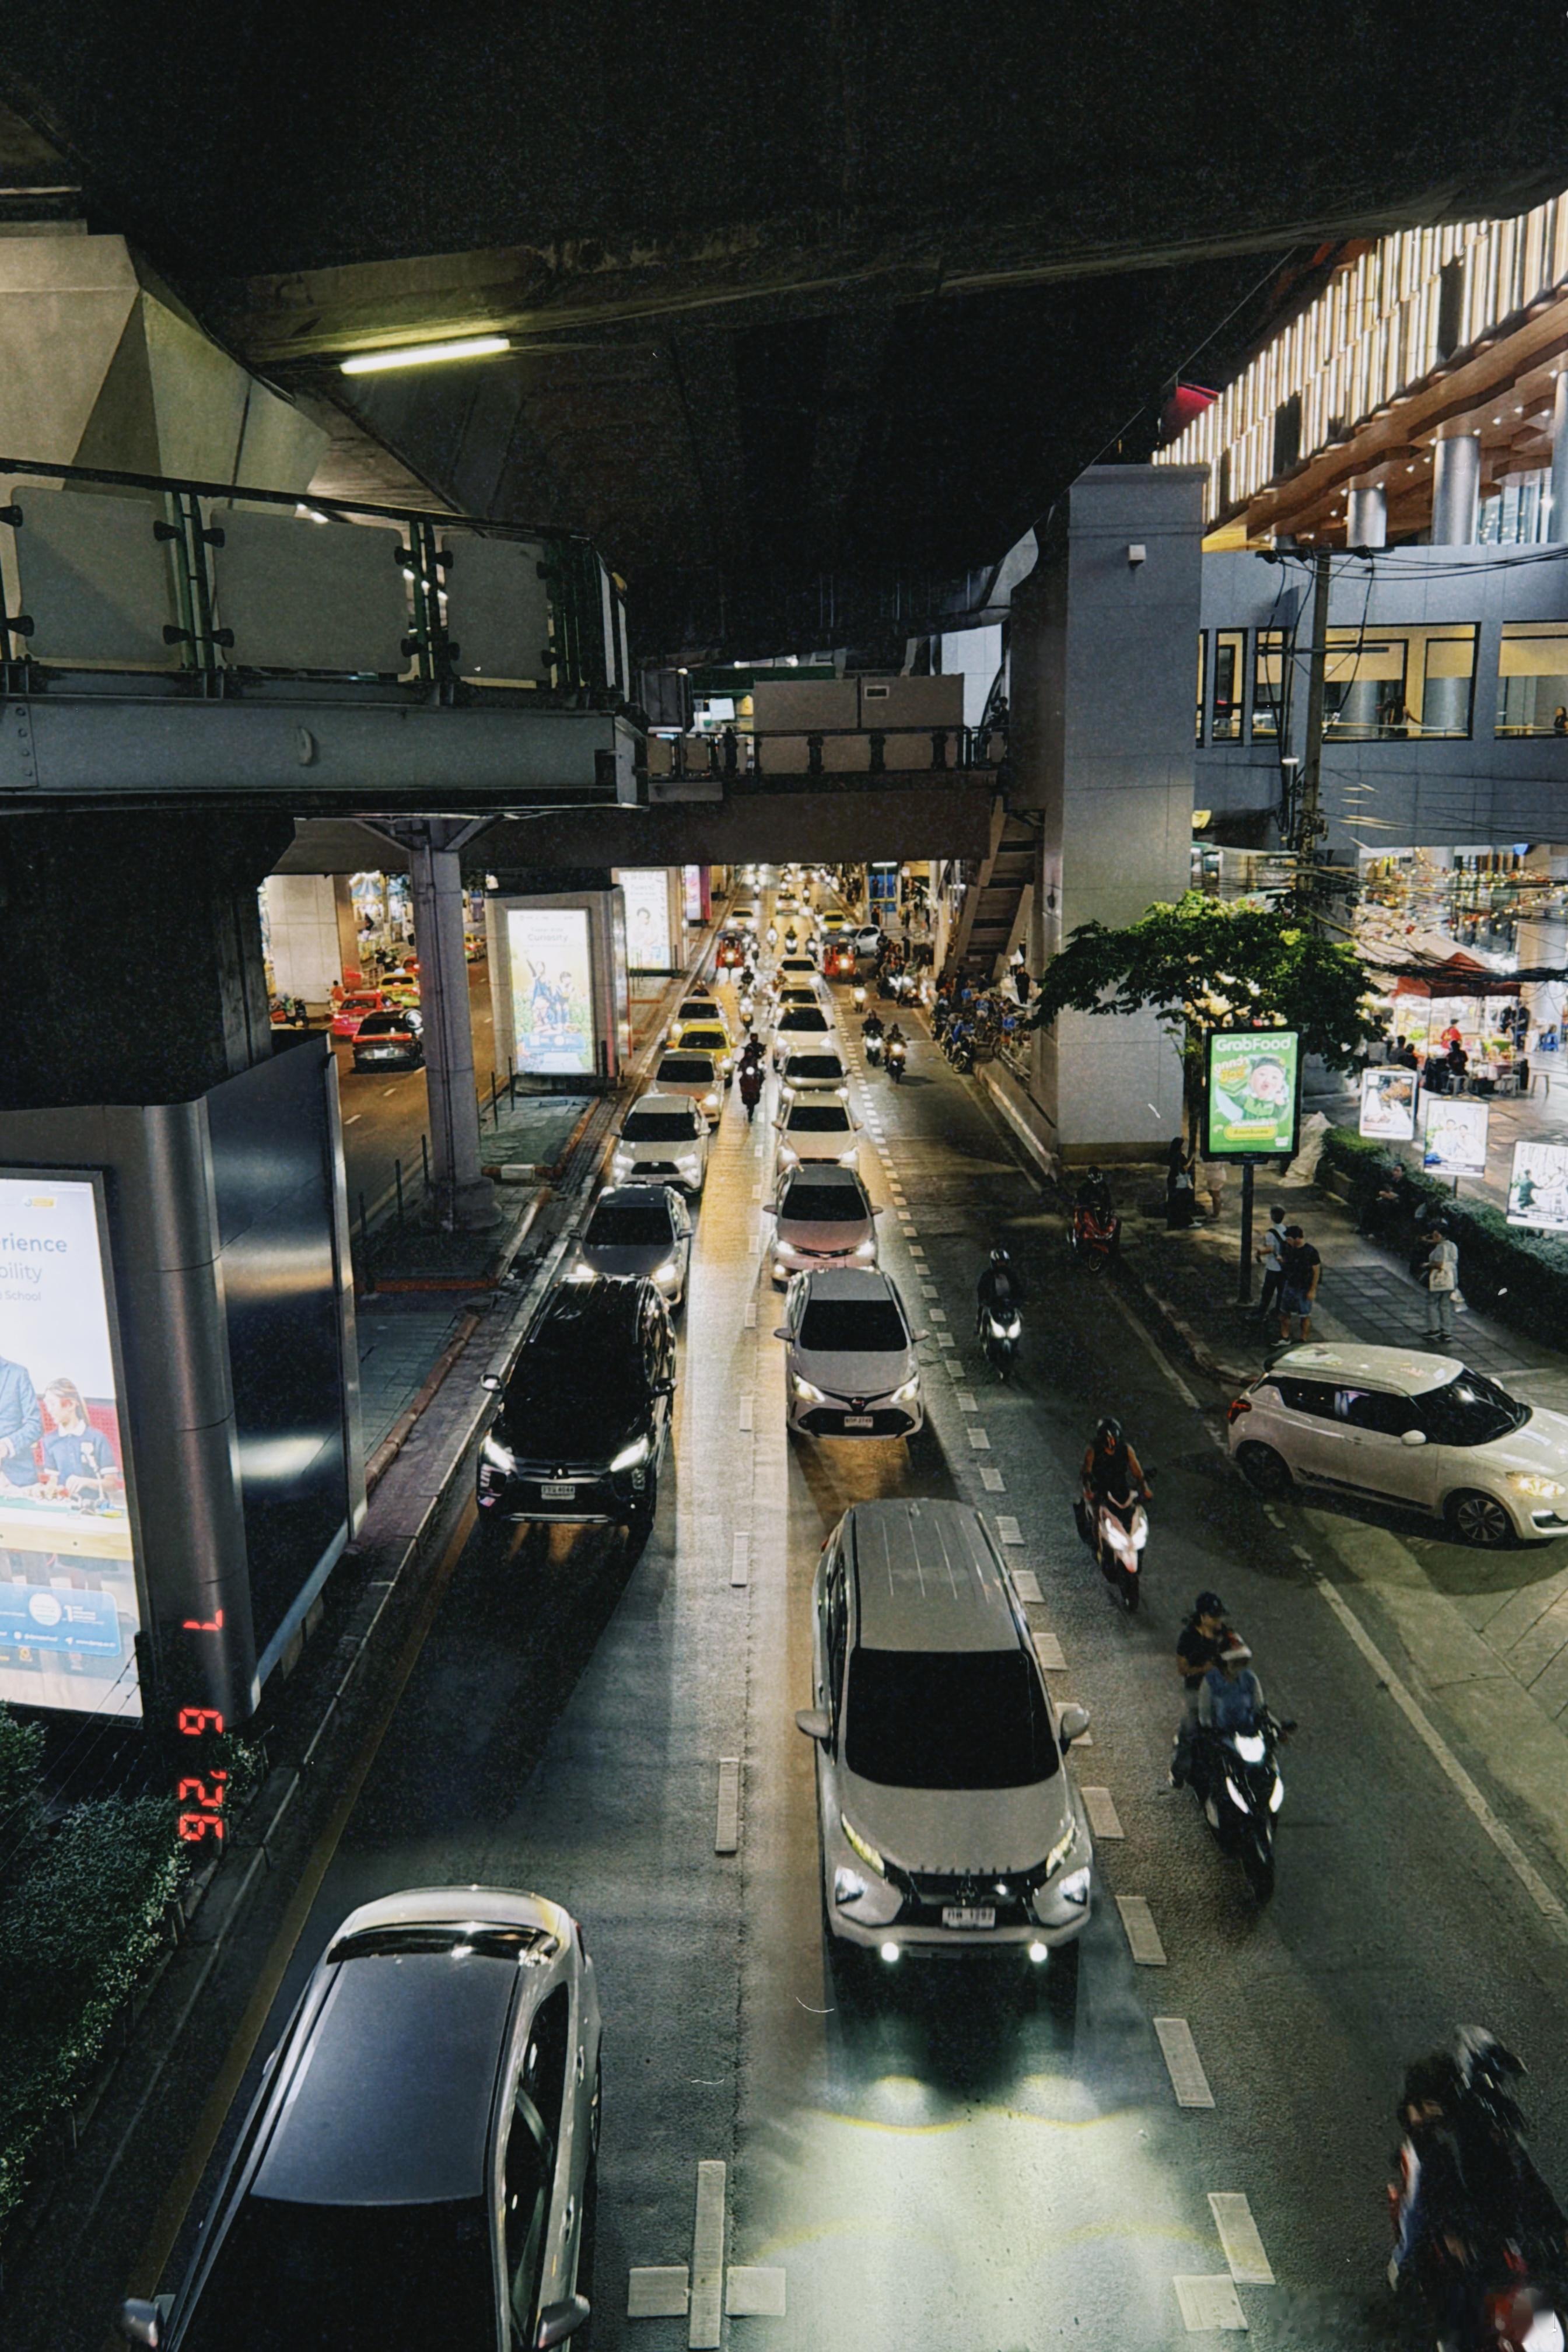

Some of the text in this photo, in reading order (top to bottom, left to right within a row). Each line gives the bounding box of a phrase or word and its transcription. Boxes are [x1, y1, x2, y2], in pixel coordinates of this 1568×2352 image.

[527, 933, 569, 943] Curiosity
[1215, 1037, 1291, 1052] GrabFood
[0, 1233, 68, 1252] rience
[5, 1290, 41, 1301] School
